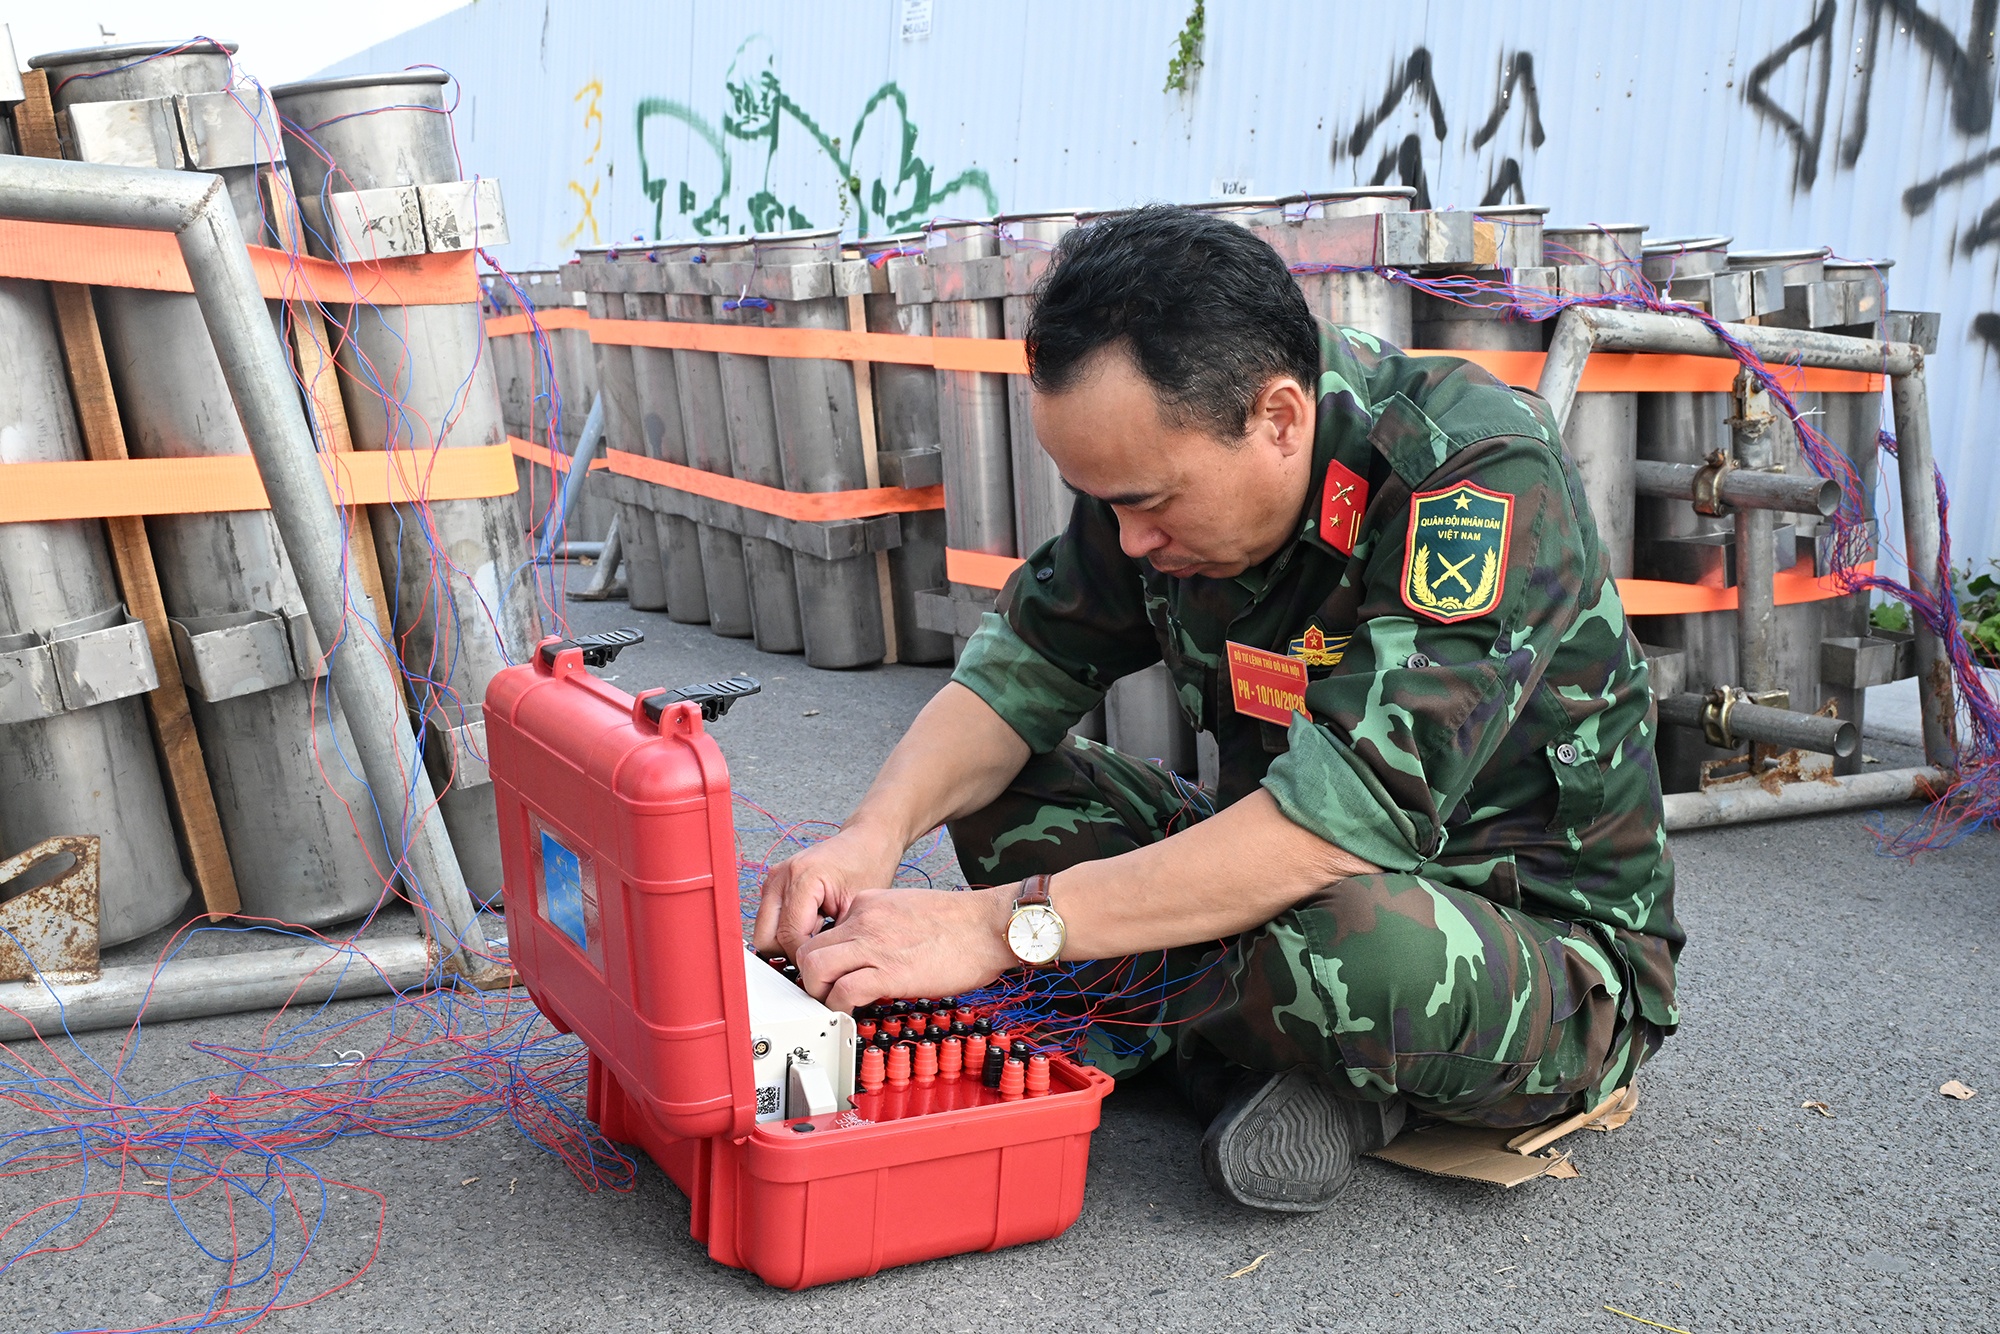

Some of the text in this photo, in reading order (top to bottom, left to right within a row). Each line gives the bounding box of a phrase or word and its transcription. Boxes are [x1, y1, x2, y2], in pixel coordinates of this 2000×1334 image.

[1420, 514, 1501, 530] QUÂN ĐỘI NHÂN DÂN
[1437, 529, 1481, 541] VIỆT NAM
[1236, 678, 1251, 700] PH
